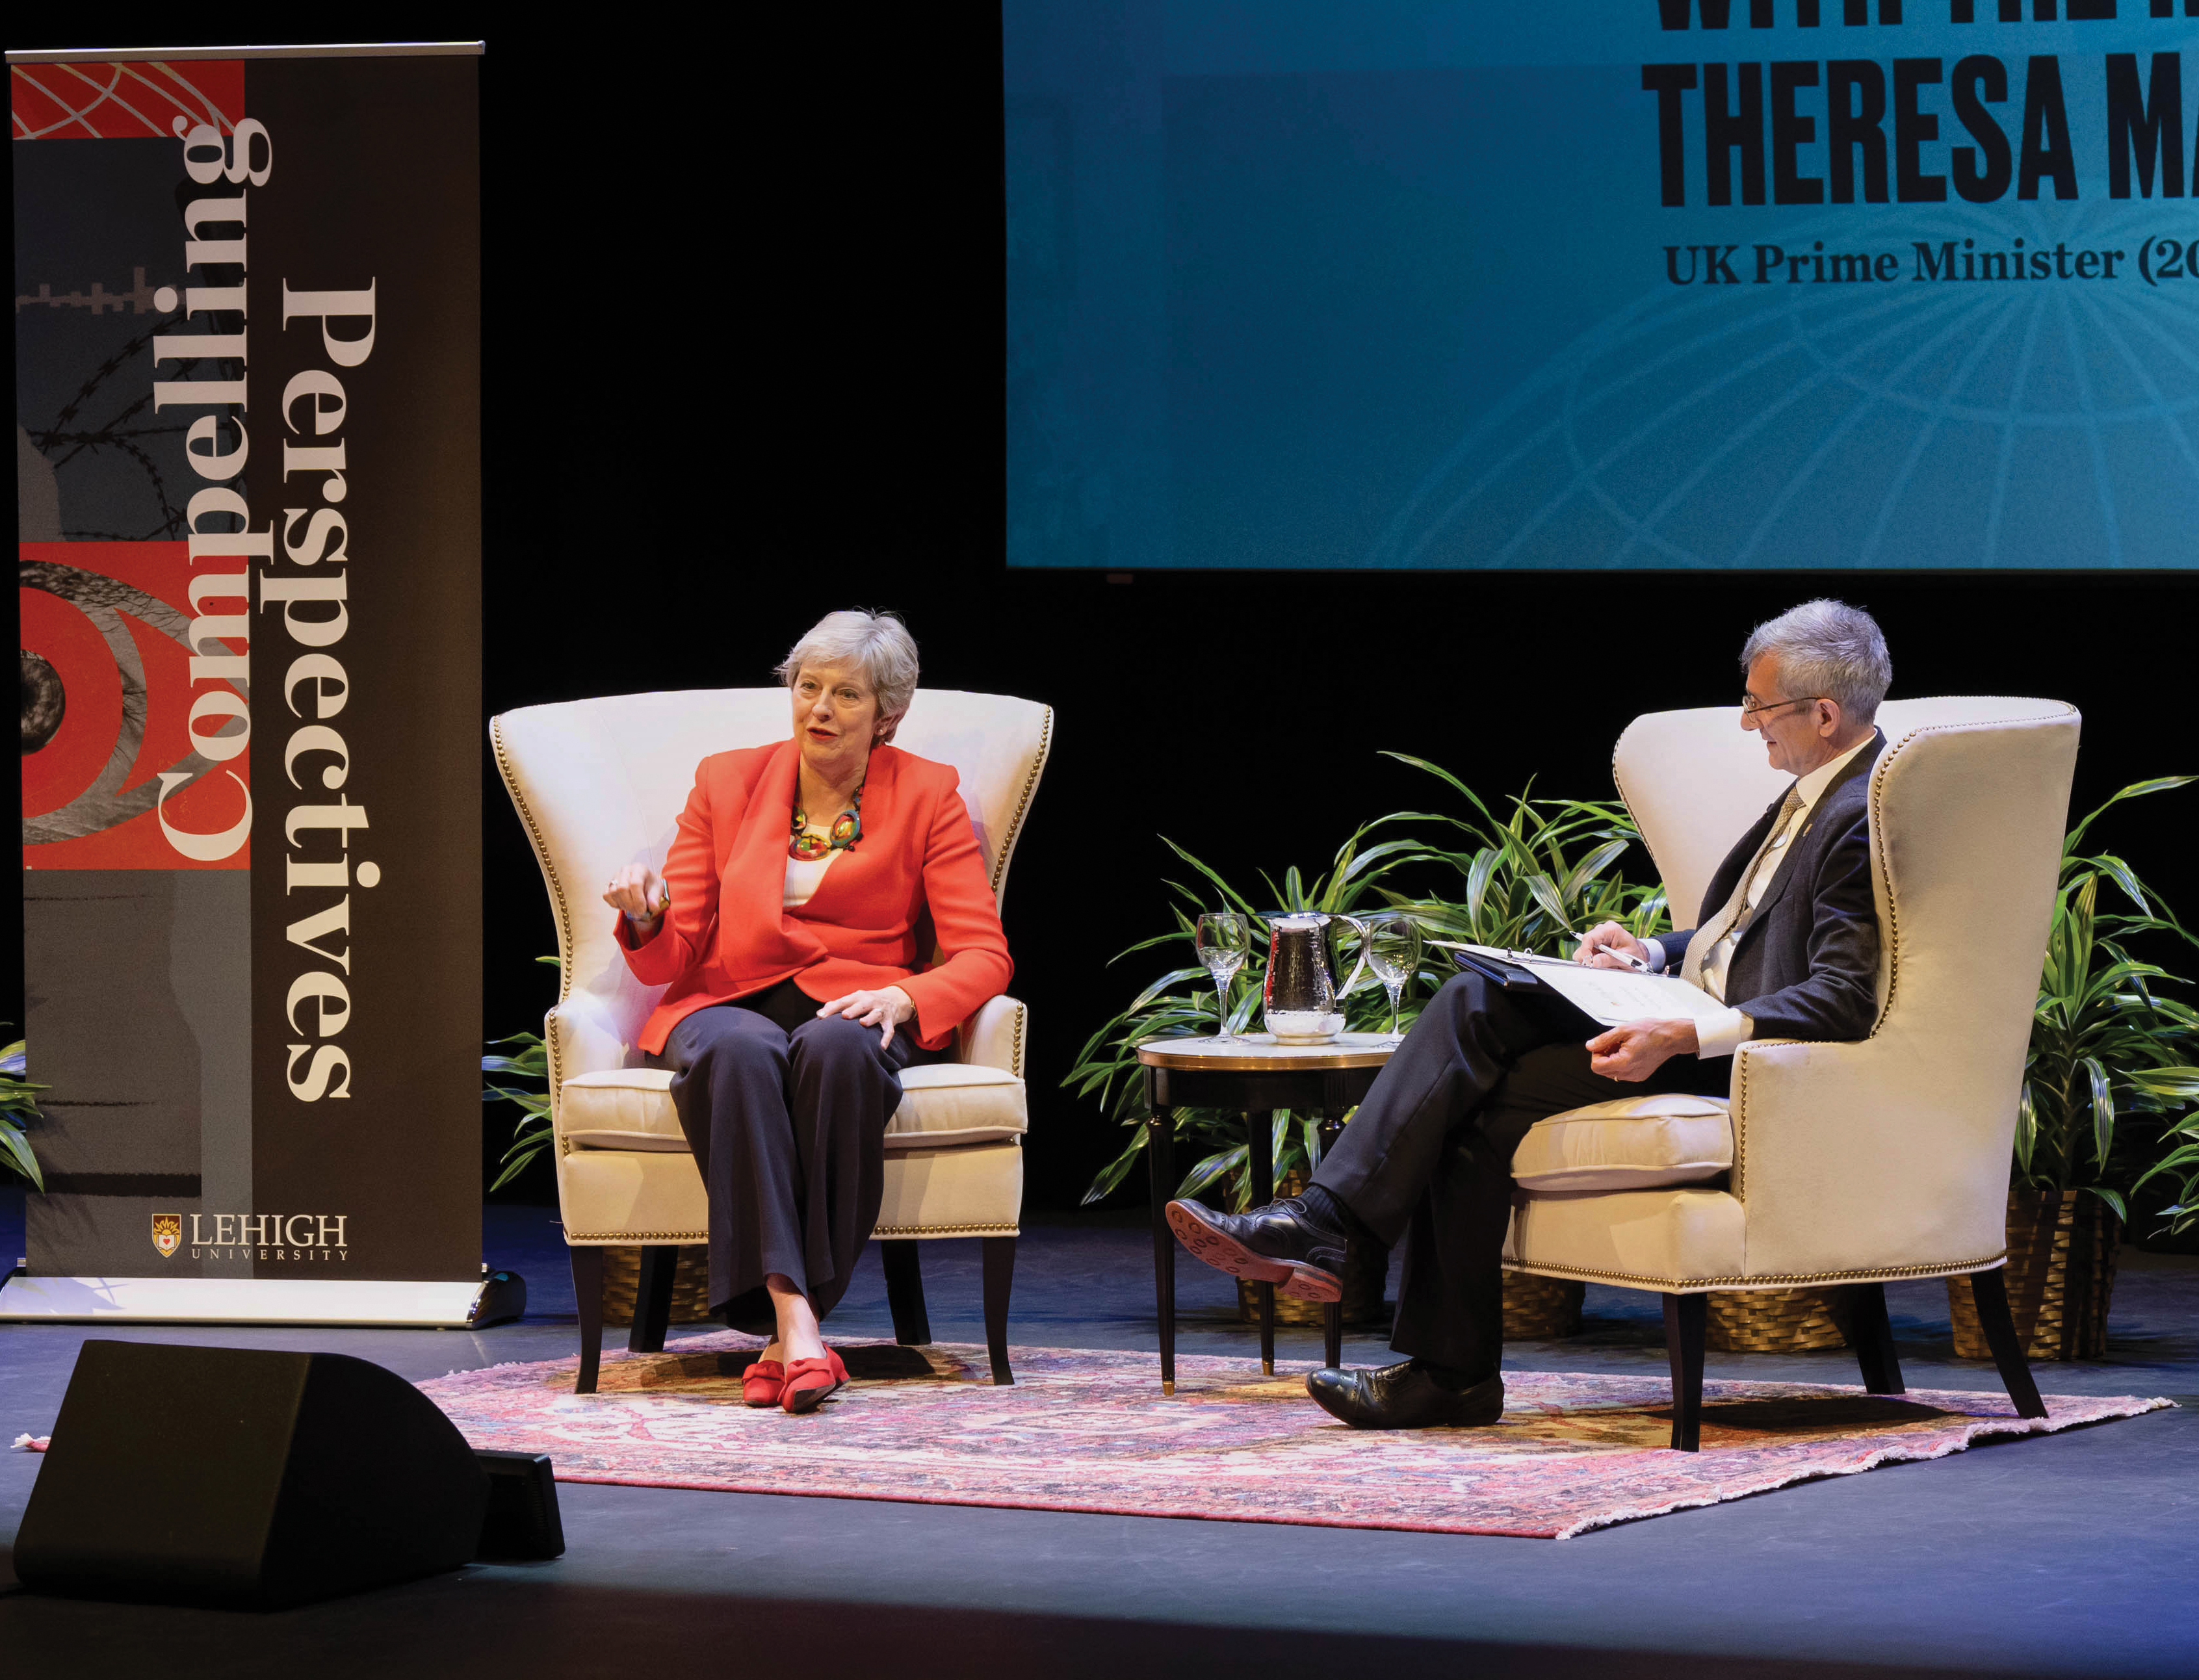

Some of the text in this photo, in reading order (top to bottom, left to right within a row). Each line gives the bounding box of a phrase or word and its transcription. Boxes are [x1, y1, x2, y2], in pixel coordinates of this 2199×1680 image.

[1641, 52, 2199, 207] THERESA M
[1662, 244, 1741, 285] UK
[1752, 240, 1899, 284] Prime
[1911, 237, 2125, 281] Minister
[153, 115, 273, 862] Compelling
[260, 276, 380, 1102] Perspectives
[189, 1214, 348, 1247] LEHIGH
[192, 1248, 348, 1261] UNIVERSITY
